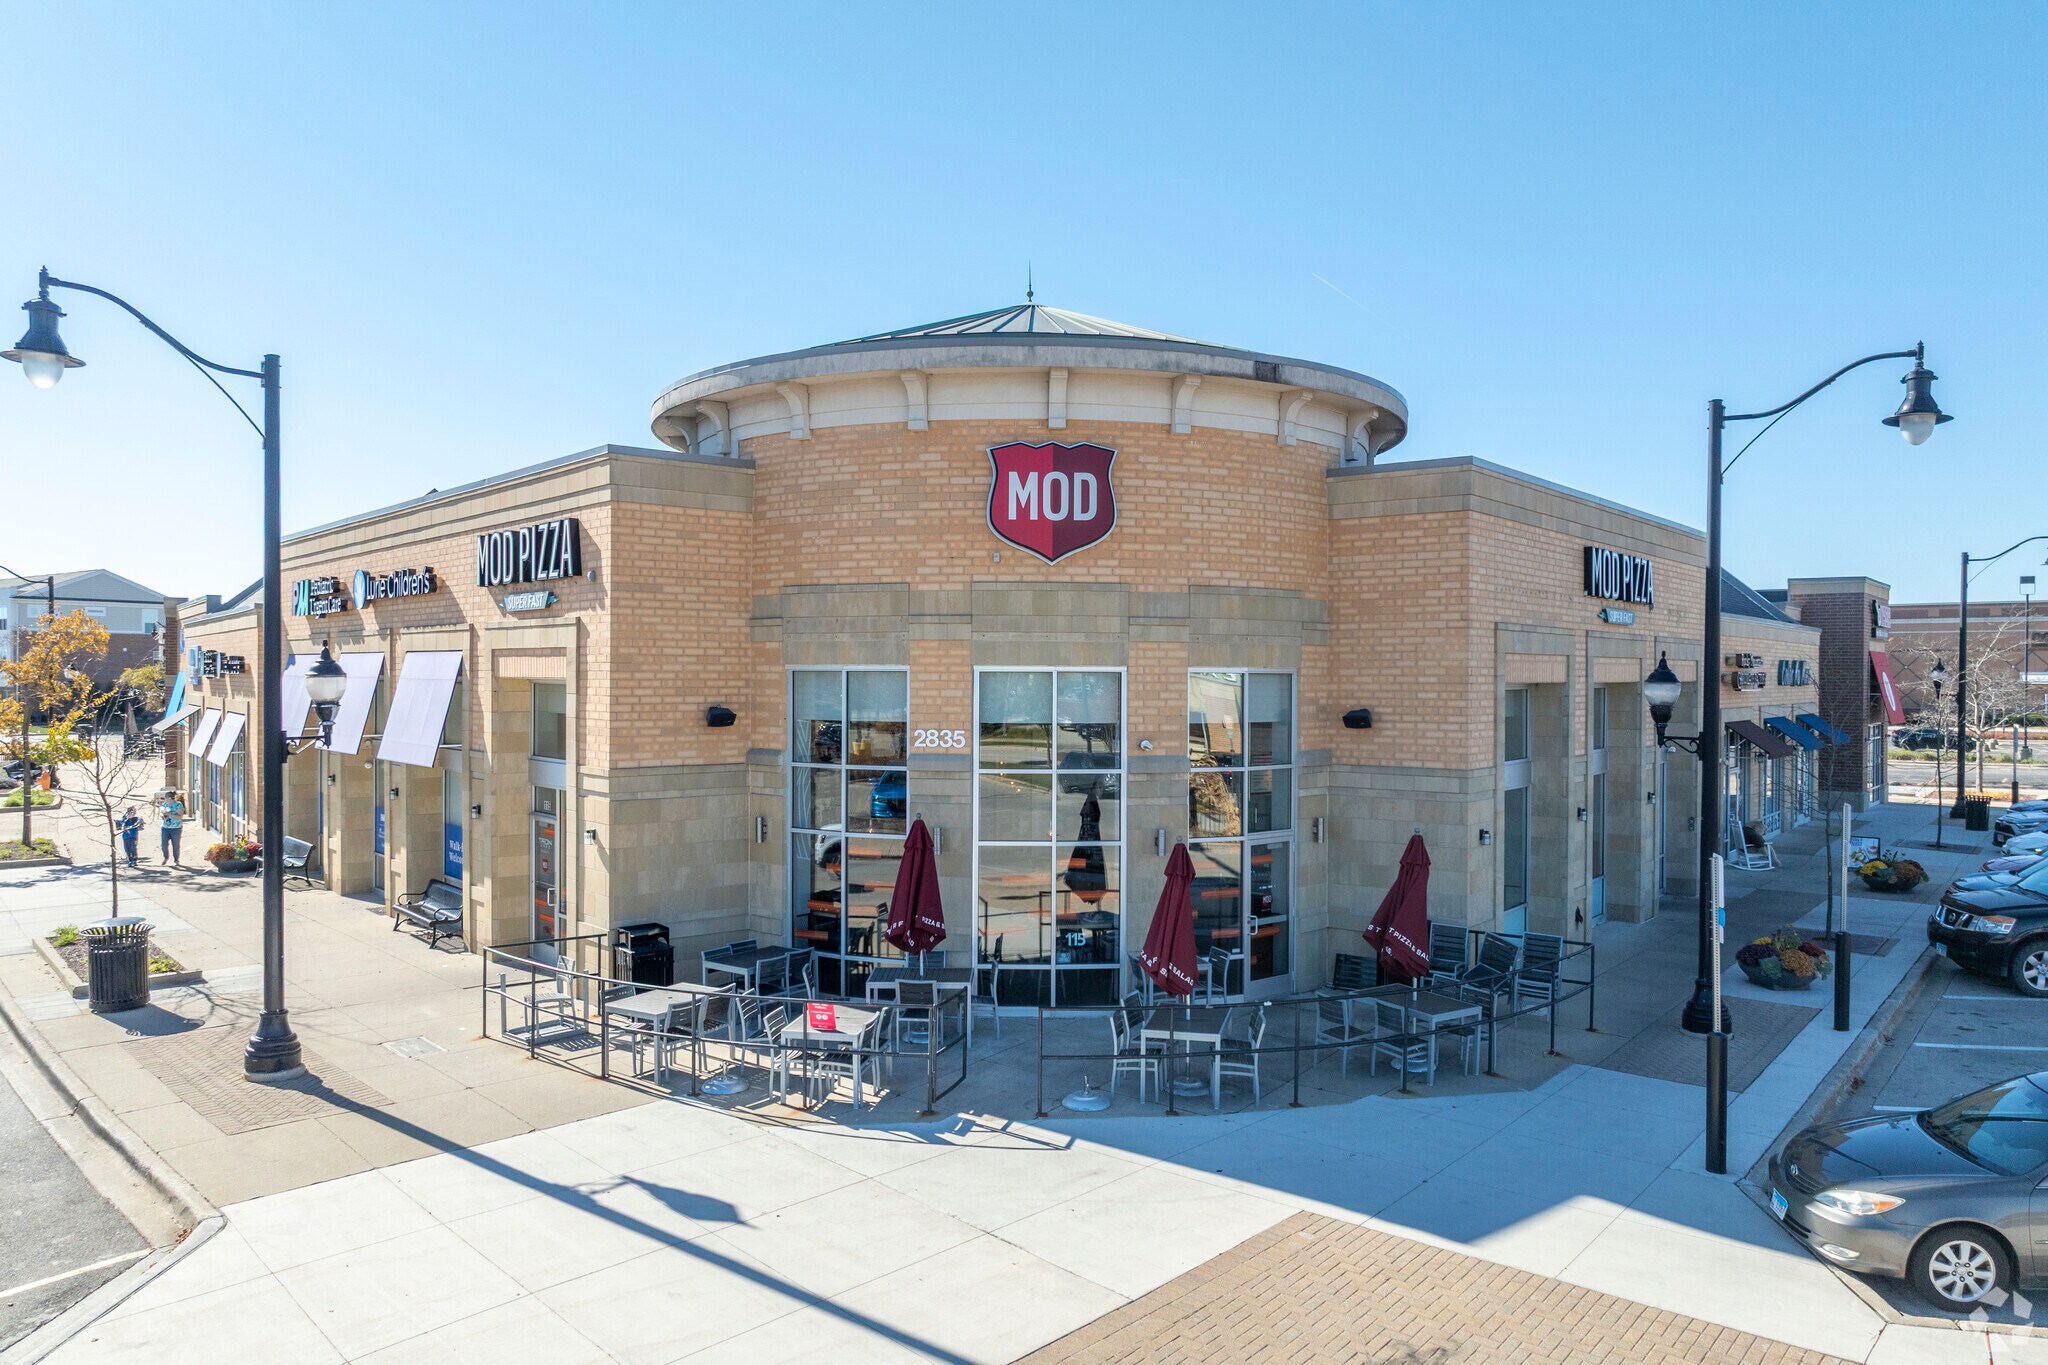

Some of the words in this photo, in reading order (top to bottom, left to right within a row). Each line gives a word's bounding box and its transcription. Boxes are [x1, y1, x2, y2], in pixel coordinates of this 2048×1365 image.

[1008, 471, 1098, 521] MOD
[476, 530, 515, 587] MOD
[519, 518, 574, 583] PIZZA
[387, 565, 431, 599] Children's
[1591, 547, 1620, 599] MOD
[1623, 554, 1654, 604] PIZZA
[507, 594, 528, 610] SUPER
[528, 592, 545, 608] FAST
[1609, 610, 1623, 622] SUPER
[1623, 612, 1634, 624] FAST
[914, 729, 966, 748] 2835
[1065, 932, 1087, 947] 115
